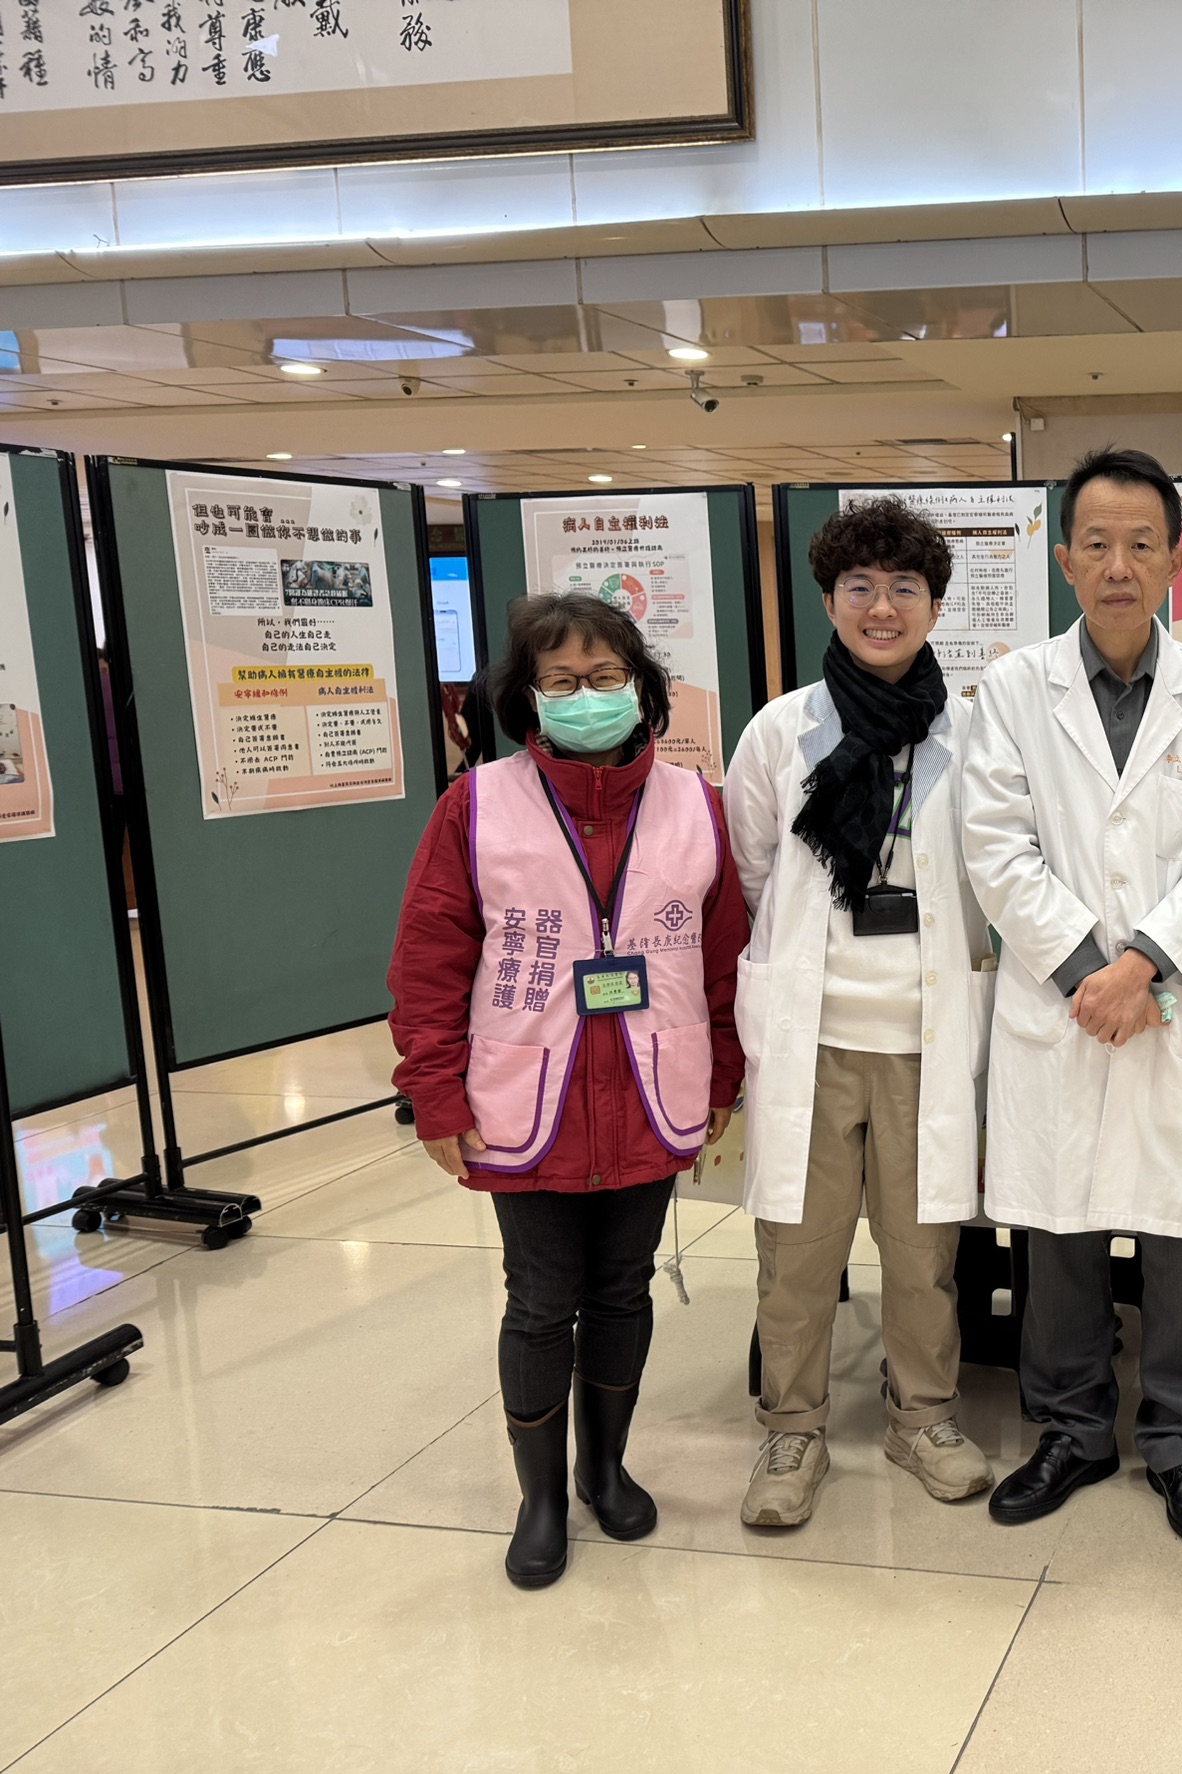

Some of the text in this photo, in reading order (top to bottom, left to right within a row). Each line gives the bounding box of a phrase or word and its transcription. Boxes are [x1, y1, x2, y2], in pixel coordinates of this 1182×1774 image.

[562, 514, 670, 533] 病人自主權利法
[264, 630, 332, 640] 自己的人生自己走
[261, 642, 337, 652] 自己的走法自己決定
[317, 685, 374, 697] 病人自主權利法
[263, 755, 279, 763] ACP
[491, 907, 526, 1010] 安寧療護
[521, 908, 562, 1013] 器官捐贈
